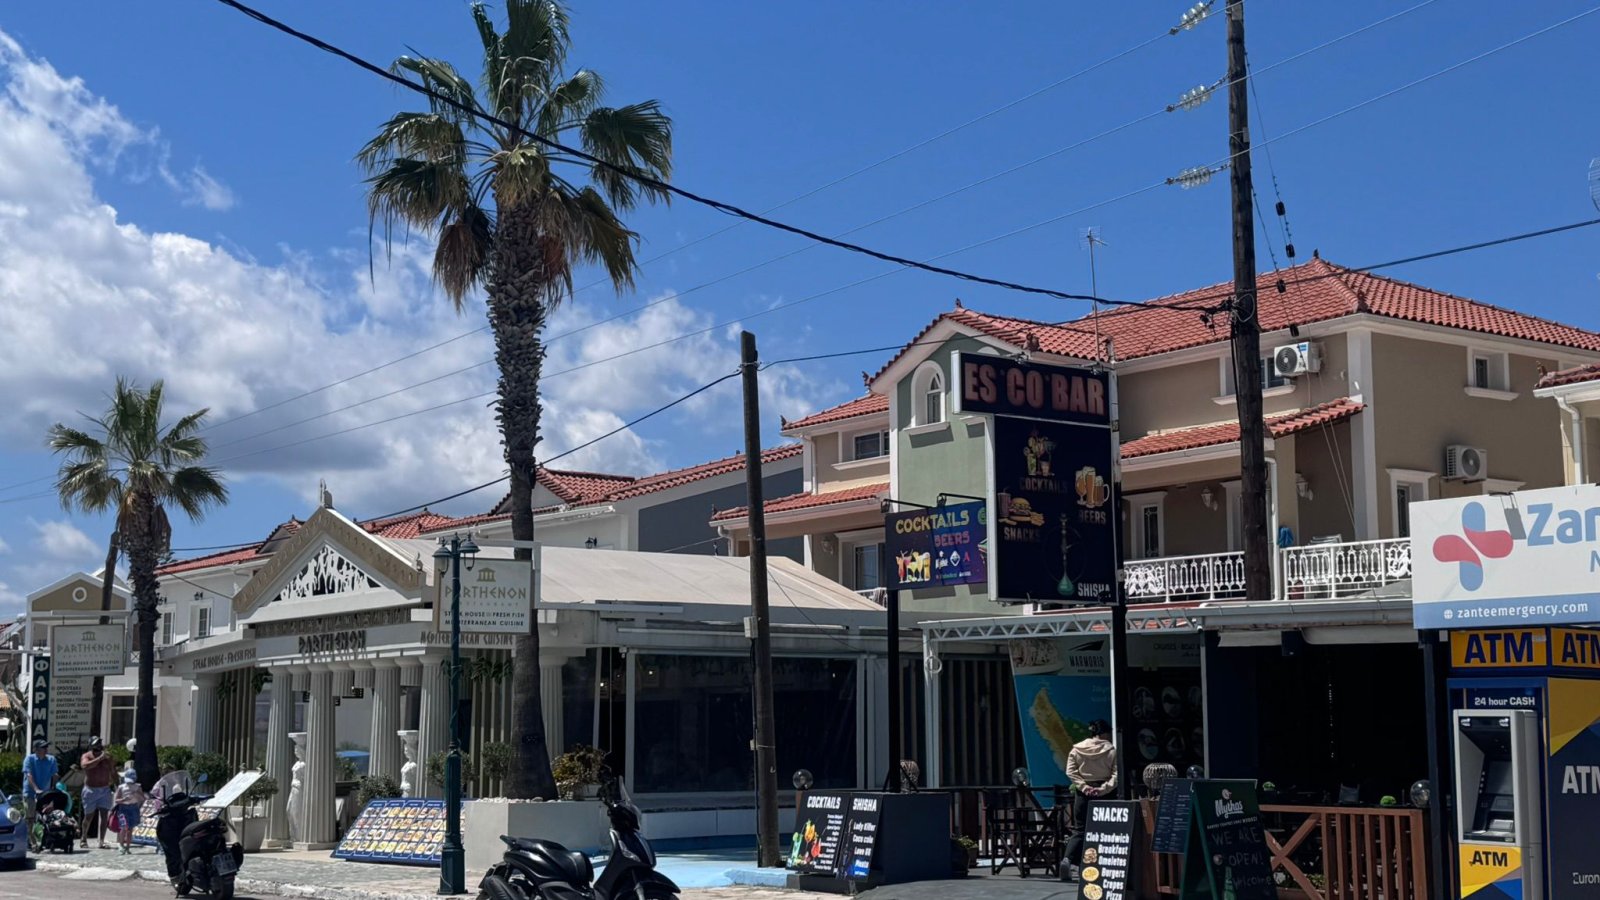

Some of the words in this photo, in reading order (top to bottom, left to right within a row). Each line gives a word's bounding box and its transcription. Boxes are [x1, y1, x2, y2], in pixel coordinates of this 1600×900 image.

[964, 362, 997, 404] ES
[1006, 368, 1044, 408] CO
[1051, 372, 1105, 416] BAR
[1020, 478, 1067, 493] COCKTAILS
[896, 510, 970, 534] COCKTAILS
[1078, 510, 1106, 524] BEERS
[934, 530, 970, 547] BEERS
[1004, 527, 1040, 540] SNACKS
[445, 586, 526, 600] PRTHENON
[1457, 602, 1588, 618] zanteemergency.com
[298, 630, 367, 653] PARTHENON
[483, 633, 513, 646] CUISINE
[57, 644, 120, 653] PARTHENON
[1464, 632, 1534, 664] ATM
[1474, 697, 1486, 705] 24
[1488, 696, 1508, 705] hour
[1509, 696, 1536, 705] CASH
[807, 796, 842, 809] COCKTAILS
[852, 798, 878, 812] SHISHA
[1214, 800, 1244, 819] Mythos
[1092, 807, 1129, 822] SNACKS
[853, 822, 863, 832] Lady
[1086, 832, 1099, 842] Club
[1100, 832, 1129, 843] Sandwich
[1212, 830, 1233, 846] WE
[1098, 844, 1128, 855] Breakfast
[1098, 856, 1126, 867] Omeletes
[1228, 852, 1264, 866] OPEN!
[1472, 850, 1508, 867] ATM
[1101, 868, 1125, 879] Burgers
[1103, 879, 1124, 890] Crepes
[1106, 890, 1122, 900] Pizza
